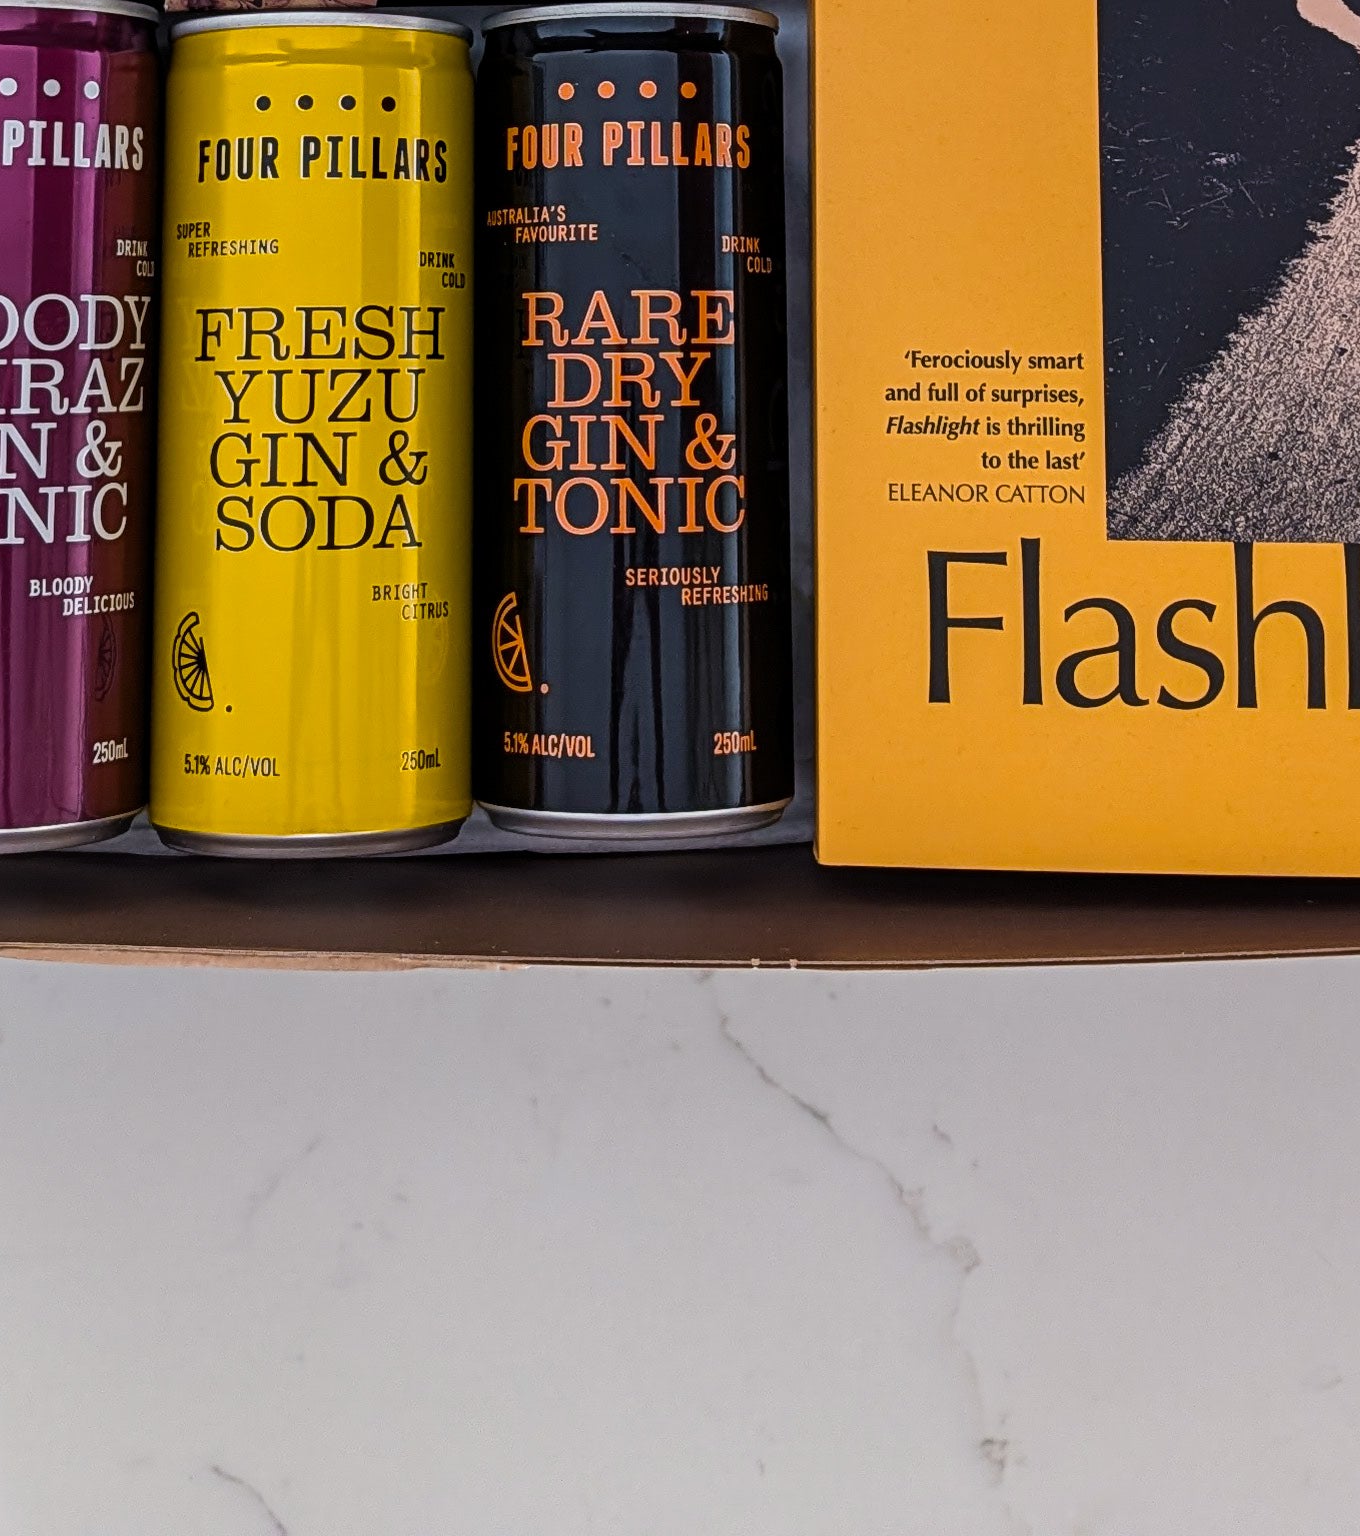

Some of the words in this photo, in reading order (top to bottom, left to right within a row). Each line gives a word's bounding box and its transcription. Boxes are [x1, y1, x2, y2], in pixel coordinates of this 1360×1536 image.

[2, 119, 144, 171] PILLARS
[507, 122, 583, 170] FOUR
[603, 121, 750, 169] PILLARS
[198, 135, 279, 183] FOUR
[301, 135, 448, 184] PILLARS
[176, 222, 211, 240] SUPER
[515, 224, 598, 244] FAVOURITE
[116, 239, 148, 256] DRINK
[188, 239, 279, 258] REFRESHING
[722, 236, 760, 253] DRINK
[419, 251, 455, 269] DRINK
[747, 256, 772, 273] COLD
[441, 272, 465, 288] COLD
[522, 290, 735, 347] RARE
[195, 305, 446, 362] FRESH
[1028, 353, 1084, 369] smart
[547, 351, 711, 408] DRY
[214, 368, 425, 424] YUZU
[885, 382, 920, 401] and
[928, 382, 958, 401] full
[966, 382, 986, 402] of
[991, 384, 1084, 408] surprises,
[886, 415, 980, 440] Flashlight
[986, 417, 1000, 435] is
[1007, 416, 1085, 442] thrilling
[75, 419, 123, 479] &
[522, 414, 664, 471] GIN
[685, 413, 736, 470] &
[210, 432, 357, 488] GIN
[378, 429, 428, 486] &
[981, 452, 1001, 469] to
[1008, 450, 1039, 469] the
[514, 474, 745, 535] TONIC
[888, 483, 989, 502] ELEANOR
[995, 484, 1084, 504] CATTON
[215, 494, 422, 552] SODA
[29, 575, 93, 597] BLOODY
[625, 566, 721, 586] SERIOUSLY
[62, 591, 134, 616] DELICIOUS
[372, 582, 428, 601] BRIGHT
[681, 584, 768, 606] REFRESHING
[401, 601, 449, 620] CITRUS
[93, 737, 128, 764] 250mL
[504, 732, 529, 754] 5.1%
[531, 734, 595, 759] ALC/VOL
[714, 731, 757, 755] 250mL
[184, 754, 210, 774] 5.1%
[215, 755, 280, 778] ALC/VOL
[401, 748, 441, 771] 250mL
